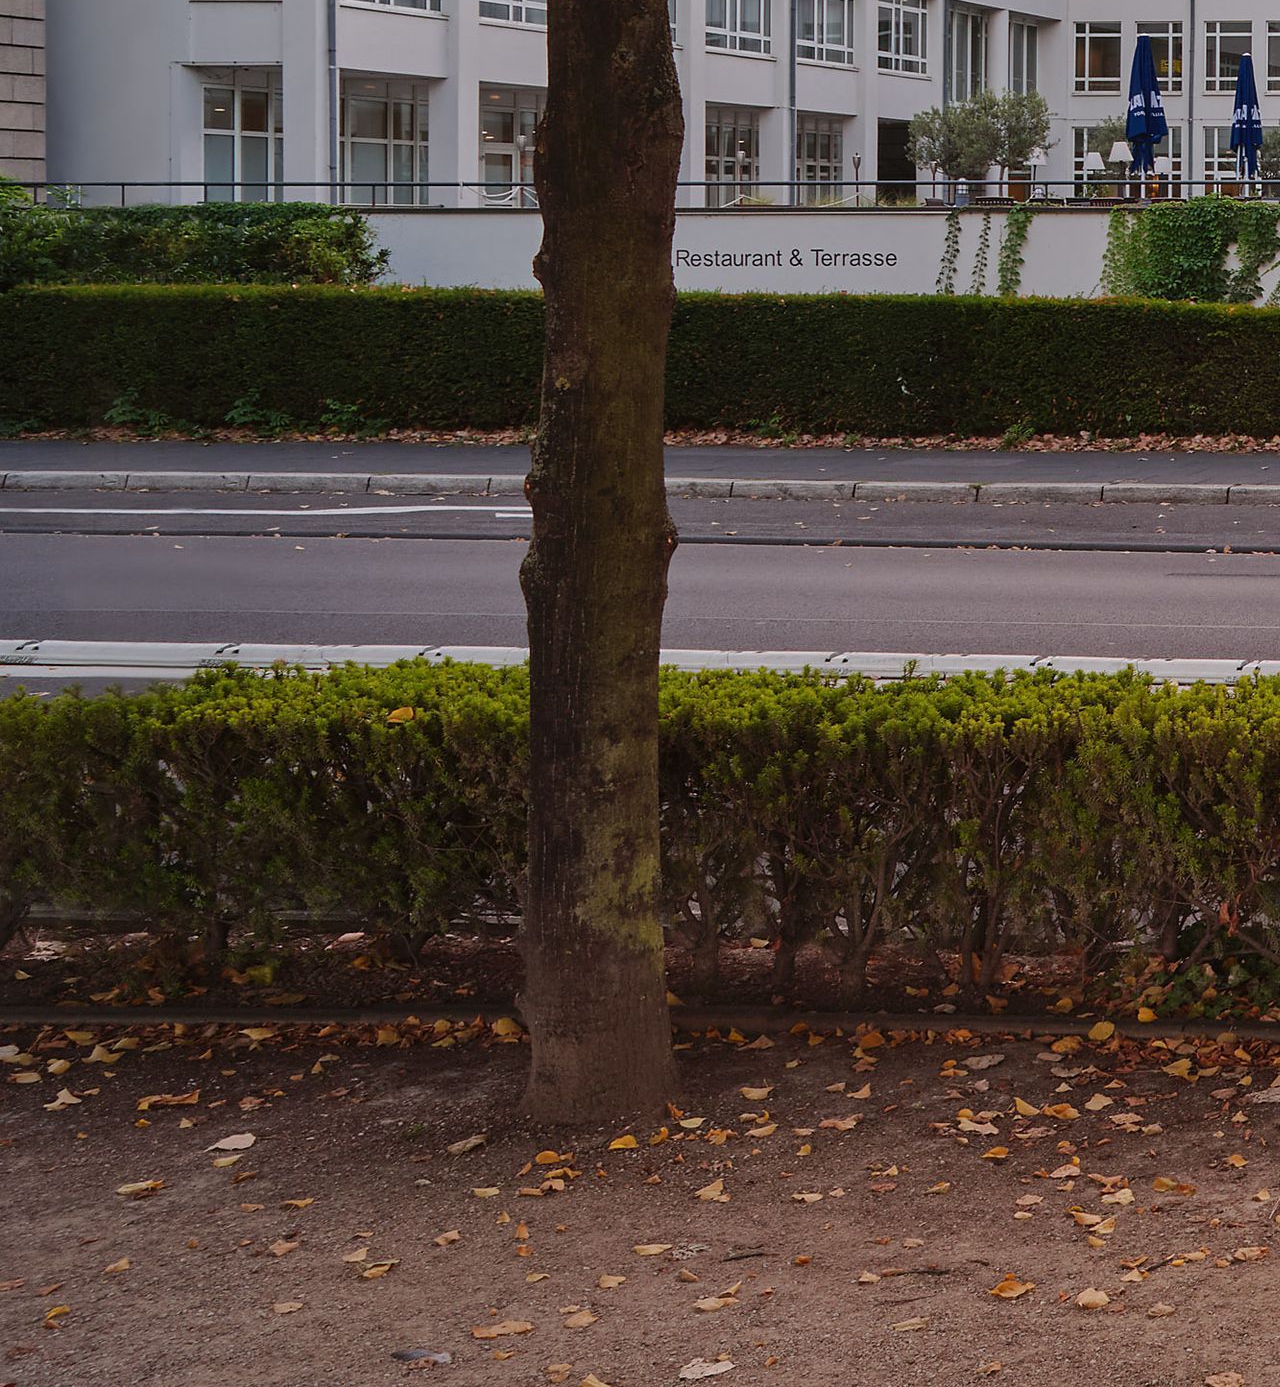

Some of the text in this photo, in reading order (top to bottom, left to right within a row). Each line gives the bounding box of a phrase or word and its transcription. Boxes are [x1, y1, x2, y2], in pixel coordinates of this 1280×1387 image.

[676, 248, 898, 267] Restaurant & Terrasse
